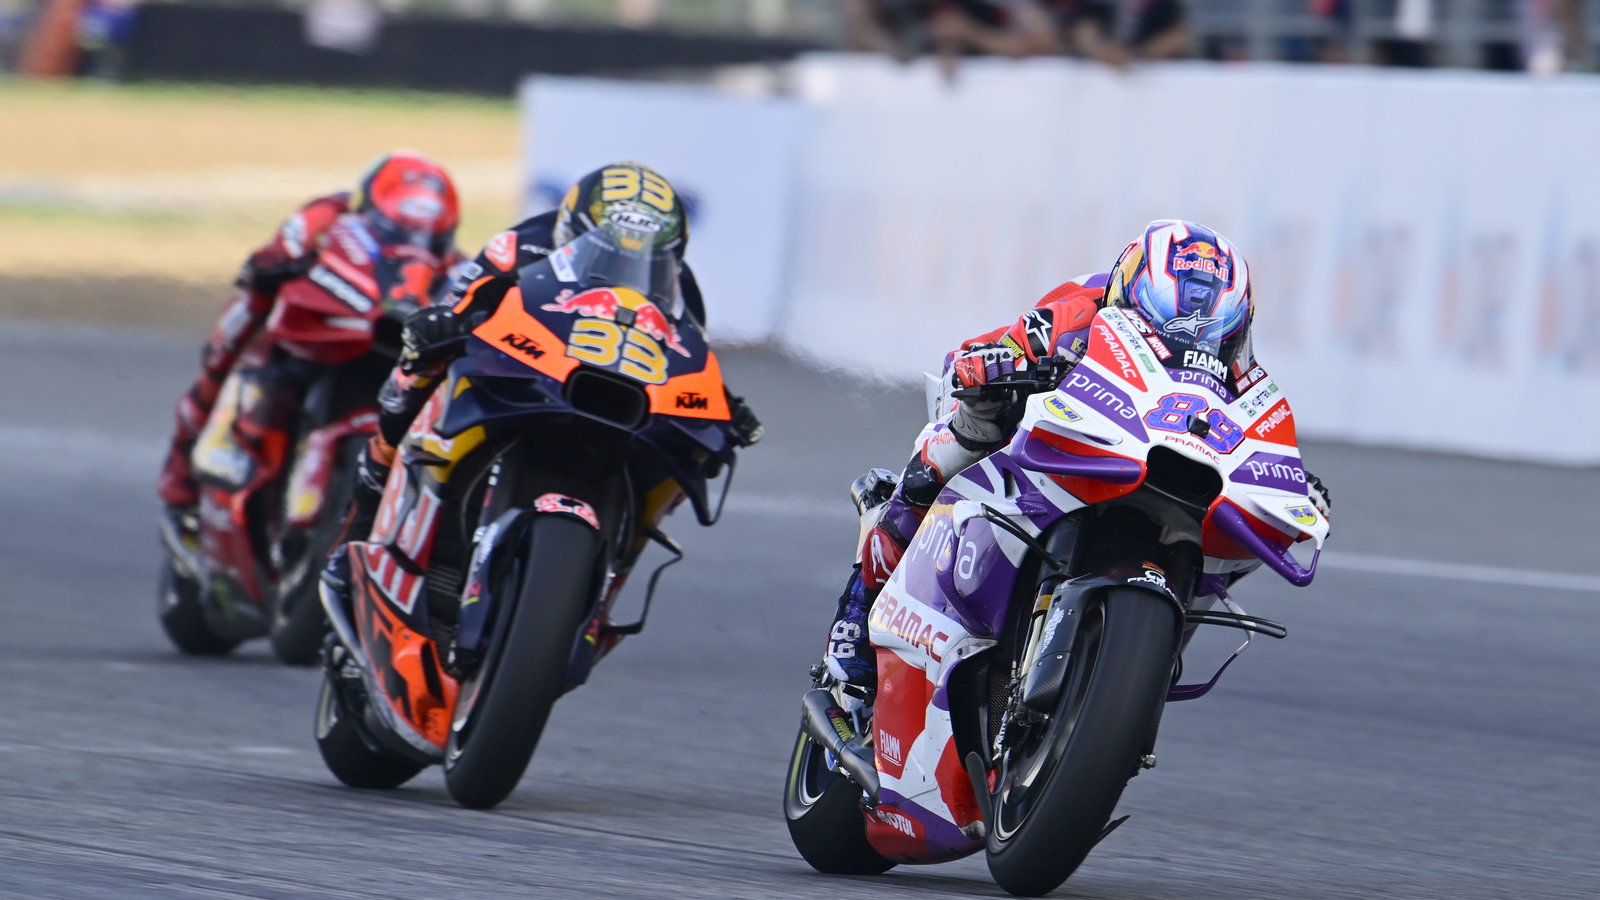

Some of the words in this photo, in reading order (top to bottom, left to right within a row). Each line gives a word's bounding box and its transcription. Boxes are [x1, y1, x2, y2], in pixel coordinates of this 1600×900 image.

[602, 168, 674, 212] 33
[1172, 257, 1202, 271] Red
[1203, 259, 1228, 282] Bull
[500, 333, 545, 359] KTM
[566, 318, 668, 384] 33
[1094, 324, 1137, 378] PRAMAC
[1146, 337, 1172, 360] MOTUL
[1183, 350, 1228, 381] FIAMM
[1065, 371, 1136, 420] prima
[1179, 370, 1227, 398] prima
[676, 392, 708, 410] KTM
[1049, 395, 1079, 422] WD-40
[1143, 393, 1245, 454] 89
[1255, 404, 1291, 438] PRAMAC
[1164, 435, 1221, 465] PRAMAC
[1246, 460, 1305, 483] prima
[874, 591, 950, 664] PRAMAC
